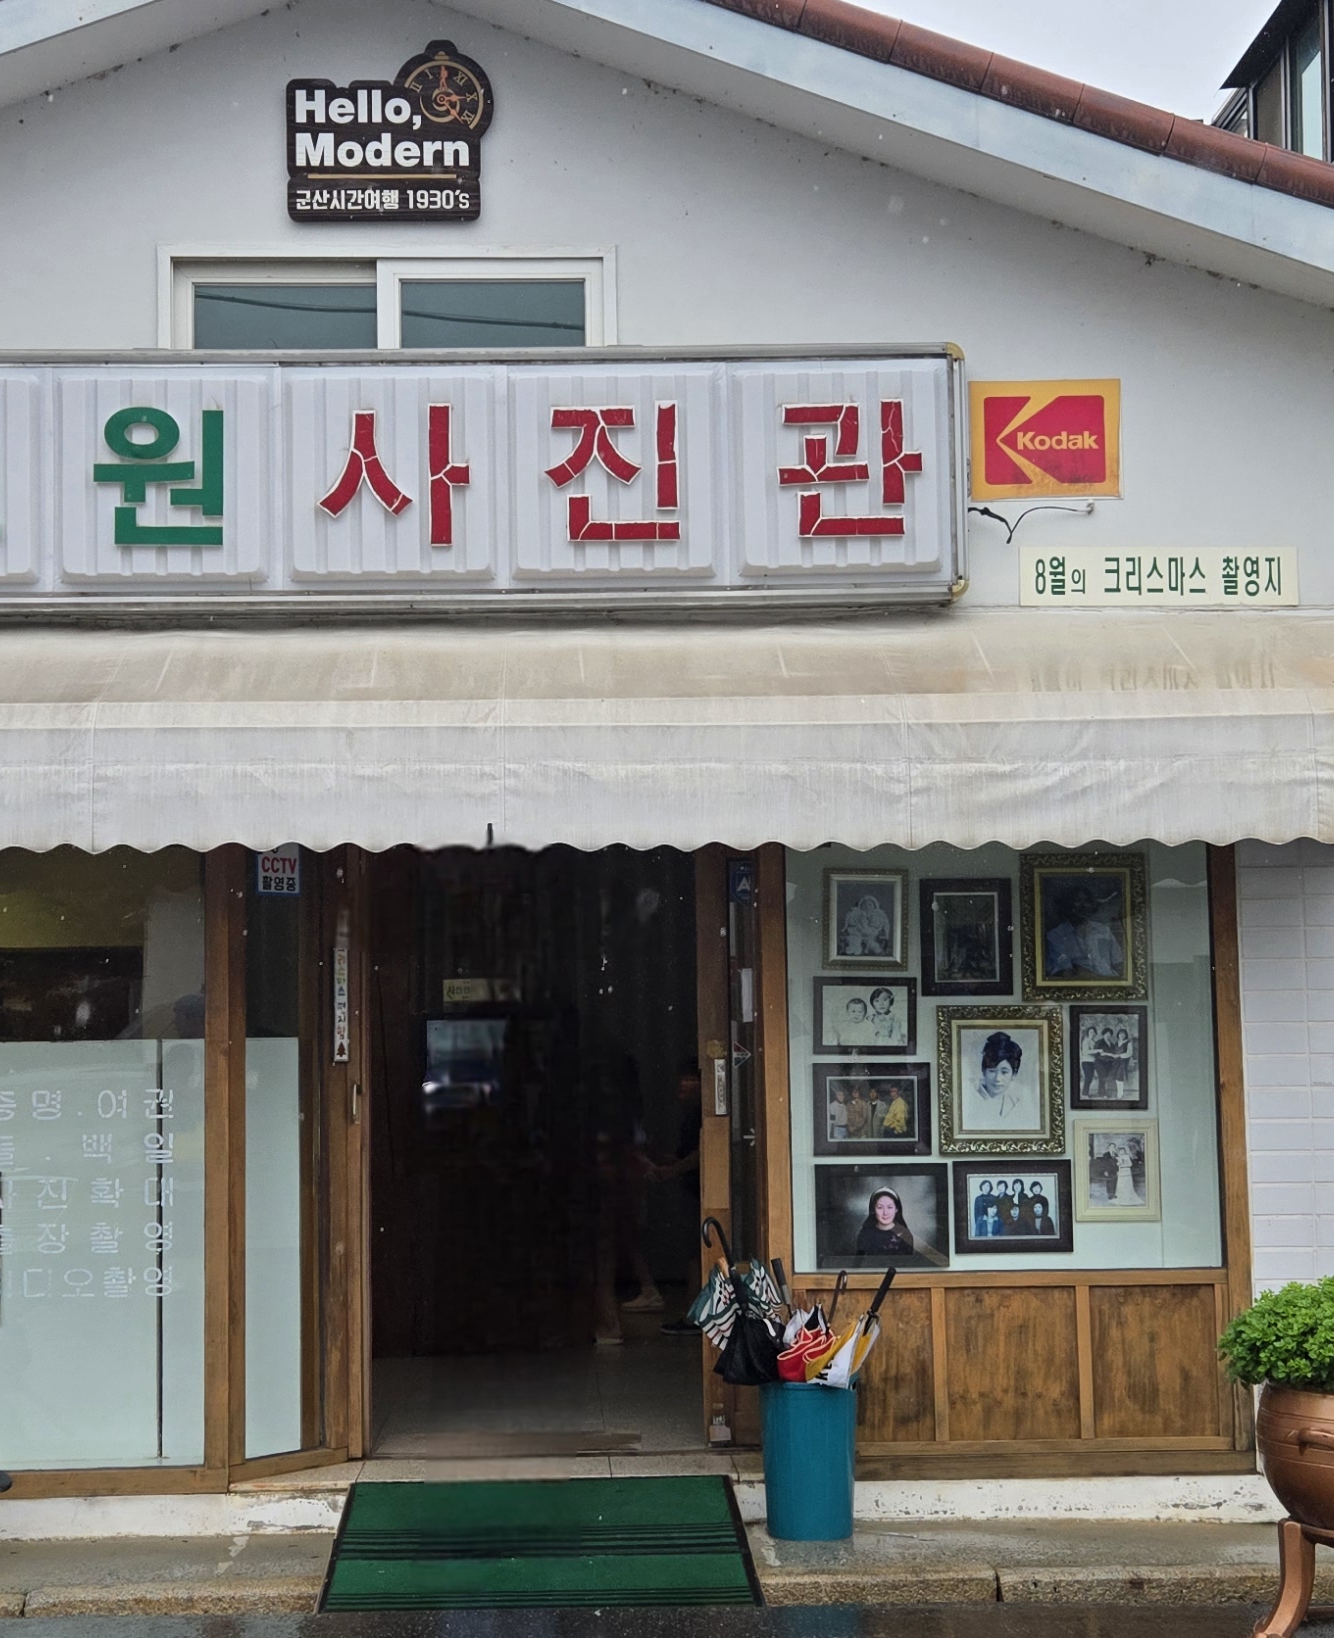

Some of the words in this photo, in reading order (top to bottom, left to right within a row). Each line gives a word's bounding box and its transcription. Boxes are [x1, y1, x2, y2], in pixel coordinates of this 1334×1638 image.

[295, 89, 422, 130] Hello,
[295, 132, 470, 167] Modern
[296, 190, 399, 210] 군산시간여행
[407, 189, 470, 209] 1930's
[1017, 430, 1099, 450] Kodak
[318, 398, 924, 547] 사진관
[1035, 556, 1086, 596] 8월의
[1104, 556, 1206, 596] 크리스마스
[1222, 555, 1281, 597] 촬영지
[261, 856, 297, 875] CCTV
[262, 876, 296, 892] 촬영중
